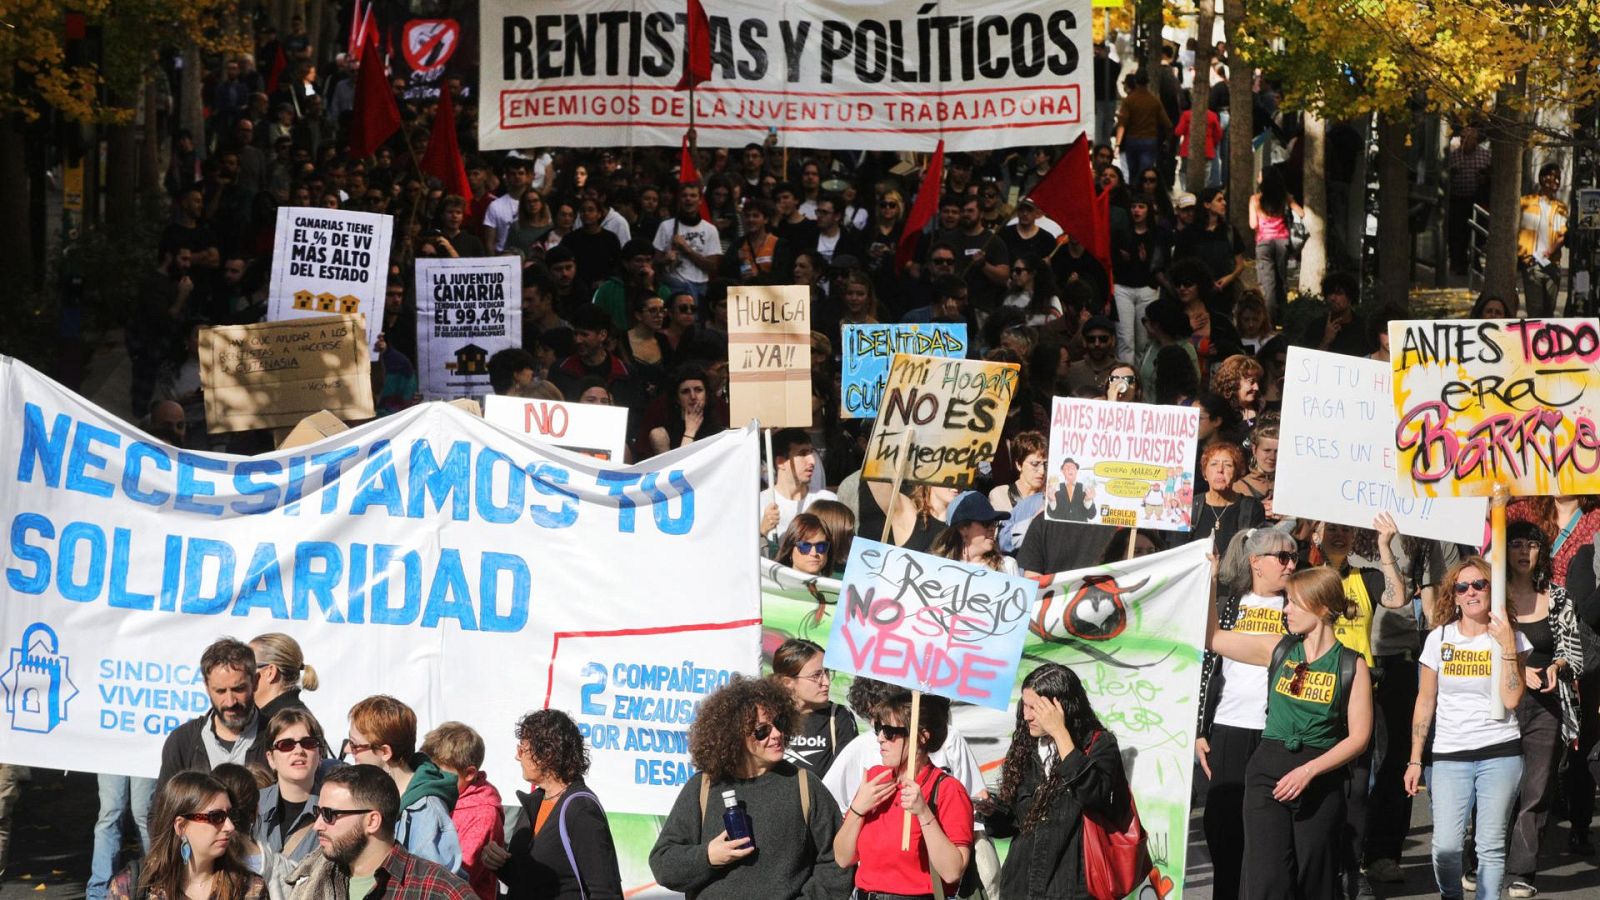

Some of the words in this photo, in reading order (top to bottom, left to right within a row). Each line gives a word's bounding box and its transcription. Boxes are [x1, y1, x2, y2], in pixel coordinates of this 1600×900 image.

[779, 20, 808, 83] Y
[821, 3, 1079, 83] POLÍTICOS
[510, 98, 640, 118] ENEMIGOS
[652, 96, 684, 117] DE
[696, 97, 727, 118] LA
[736, 100, 873, 122] JUVENTUD
[885, 95, 1072, 122] TRABAJADORA
[293, 229, 308, 243] EL
[313, 231, 327, 245] %
[331, 233, 349, 247] DE
[354, 235, 372, 250] VV
[295, 217, 343, 231] CANARIAS
[347, 222, 374, 235] TIENE
[291, 242, 327, 263] MÁS
[331, 249, 371, 268] ALTO
[290, 262, 315, 277] DEL
[319, 266, 369, 283] ESTADO
[433, 273, 447, 285] LA
[450, 272, 504, 284] JUVENTUD
[434, 284, 504, 301] CANARIA
[478, 301, 505, 309] DEDICAR
[434, 310, 451, 325] EL
[456, 308, 504, 325] 99,4%
[736, 295, 805, 326] HUELGA
[252, 336, 270, 346] QUE
[275, 332, 310, 343] AYUDAR
[319, 330, 326, 339] A
[331, 328, 347, 337] LOS
[283, 346, 290, 354] A
[1395, 322, 1503, 372] ANTES
[1300, 358, 1320, 383] SI
[1336, 366, 1360, 387] TU
[524, 402, 569, 438] NO
[883, 388, 939, 427] NO
[943, 397, 998, 433] ES
[1053, 403, 1093, 430] ANTES
[1097, 404, 1135, 433] HABÍA
[1141, 410, 1197, 439] FAMILIAS
[1303, 396, 1345, 420] PAGA
[1358, 400, 1375, 421] TU
[1062, 432, 1088, 455] HOY
[1126, 437, 1185, 464] TURISTAS
[1294, 435, 1340, 460] ERES
[1350, 443, 1371, 462] UN
[17, 402, 580, 529] NECESITAMOS
[596, 469, 696, 536] TU
[1102, 516, 1137, 527] HABITABLE
[6, 512, 532, 633] SOLIDARIDAD
[845, 583, 906, 631] NO
[912, 605, 988, 650] SE
[841, 624, 1008, 698] VENDE
[1443, 649, 1491, 662] #REALEJ
[1443, 662, 1491, 676] HABITABL
[99, 659, 203, 685] SINDICA
[98, 684, 210, 712] VIVIEND
[580, 661, 608, 716] 2
[1277, 678, 1331, 702] HATABLE
[100, 709, 136, 733] DE
[578, 722, 620, 750] POR
[635, 758, 696, 787] DESA
